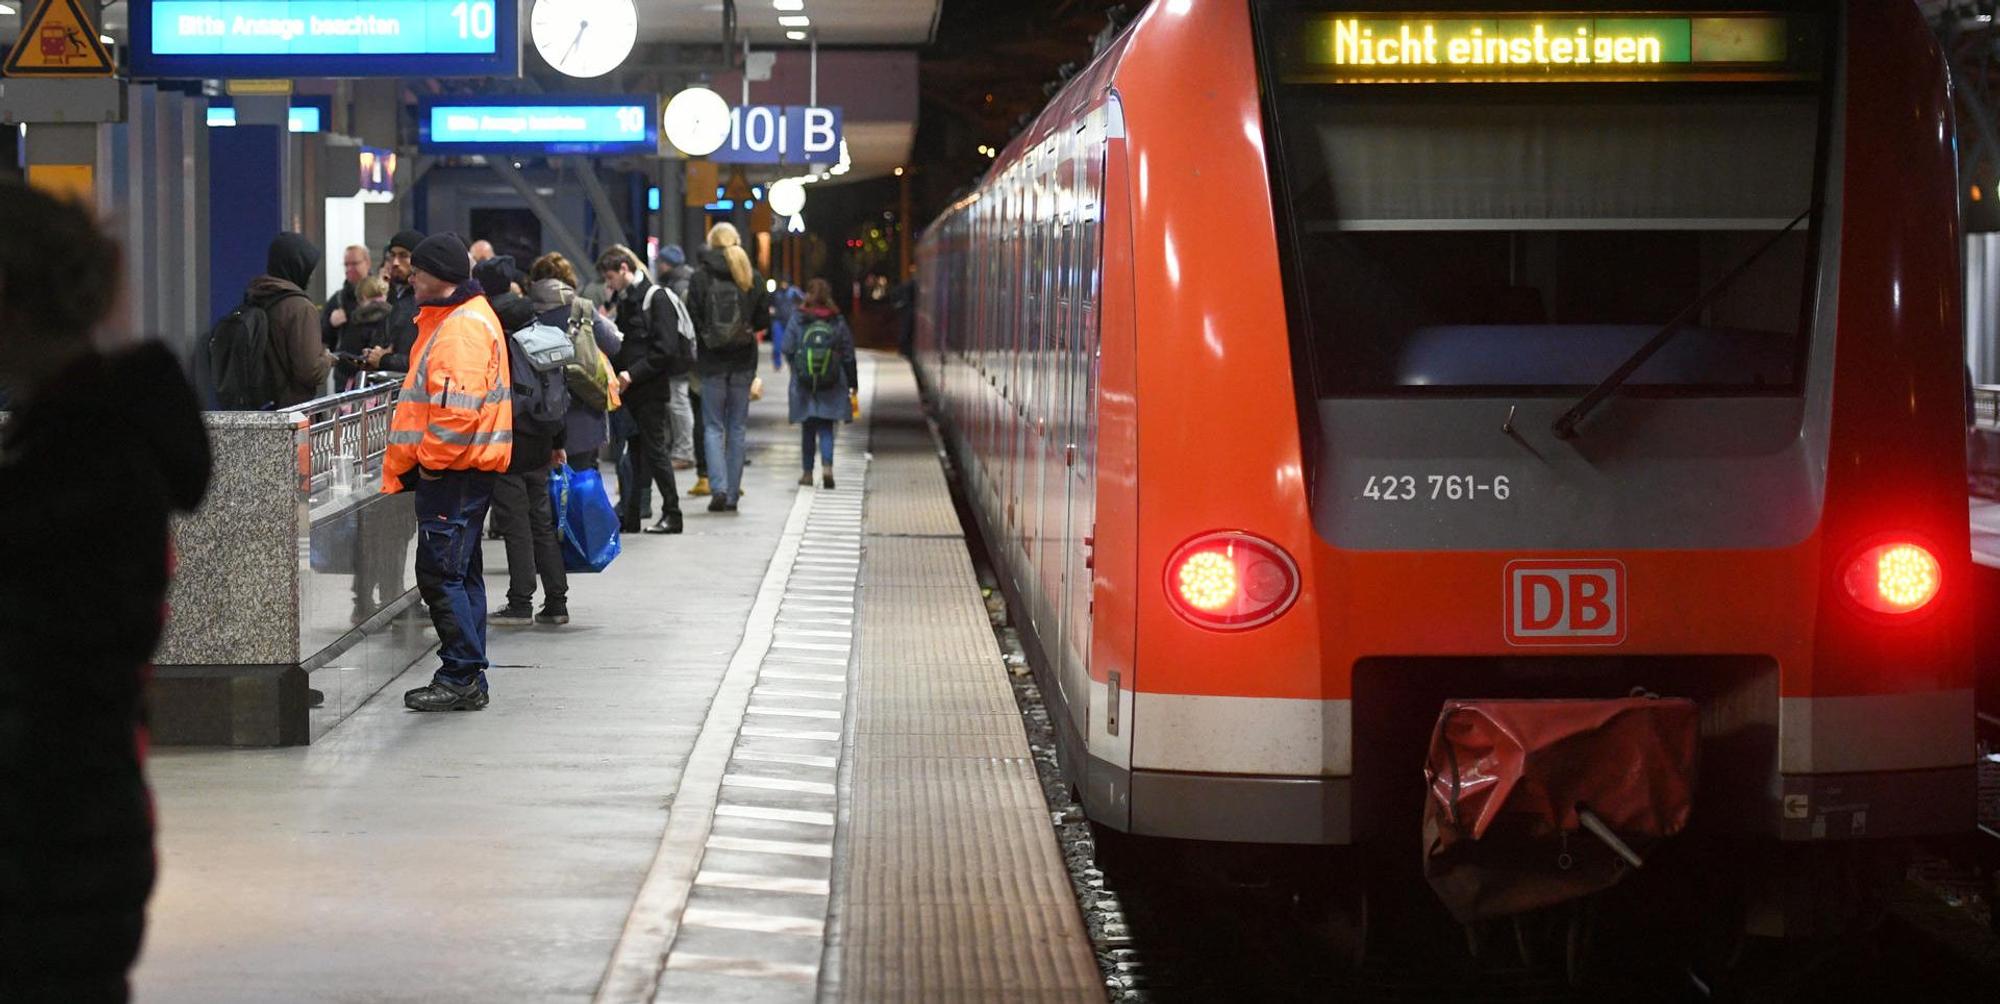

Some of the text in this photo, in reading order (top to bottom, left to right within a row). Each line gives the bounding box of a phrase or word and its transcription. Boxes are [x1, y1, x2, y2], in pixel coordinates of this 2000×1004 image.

[451, 1, 493, 39] 10
[1335, 19, 1661, 65] Nicht einsteigen
[615, 106, 643, 132] 10
[731, 106, 775, 152] 10
[804, 107, 836, 152] B
[1363, 475, 1510, 500] 423 761-6
[1520, 574, 1612, 630] DB
